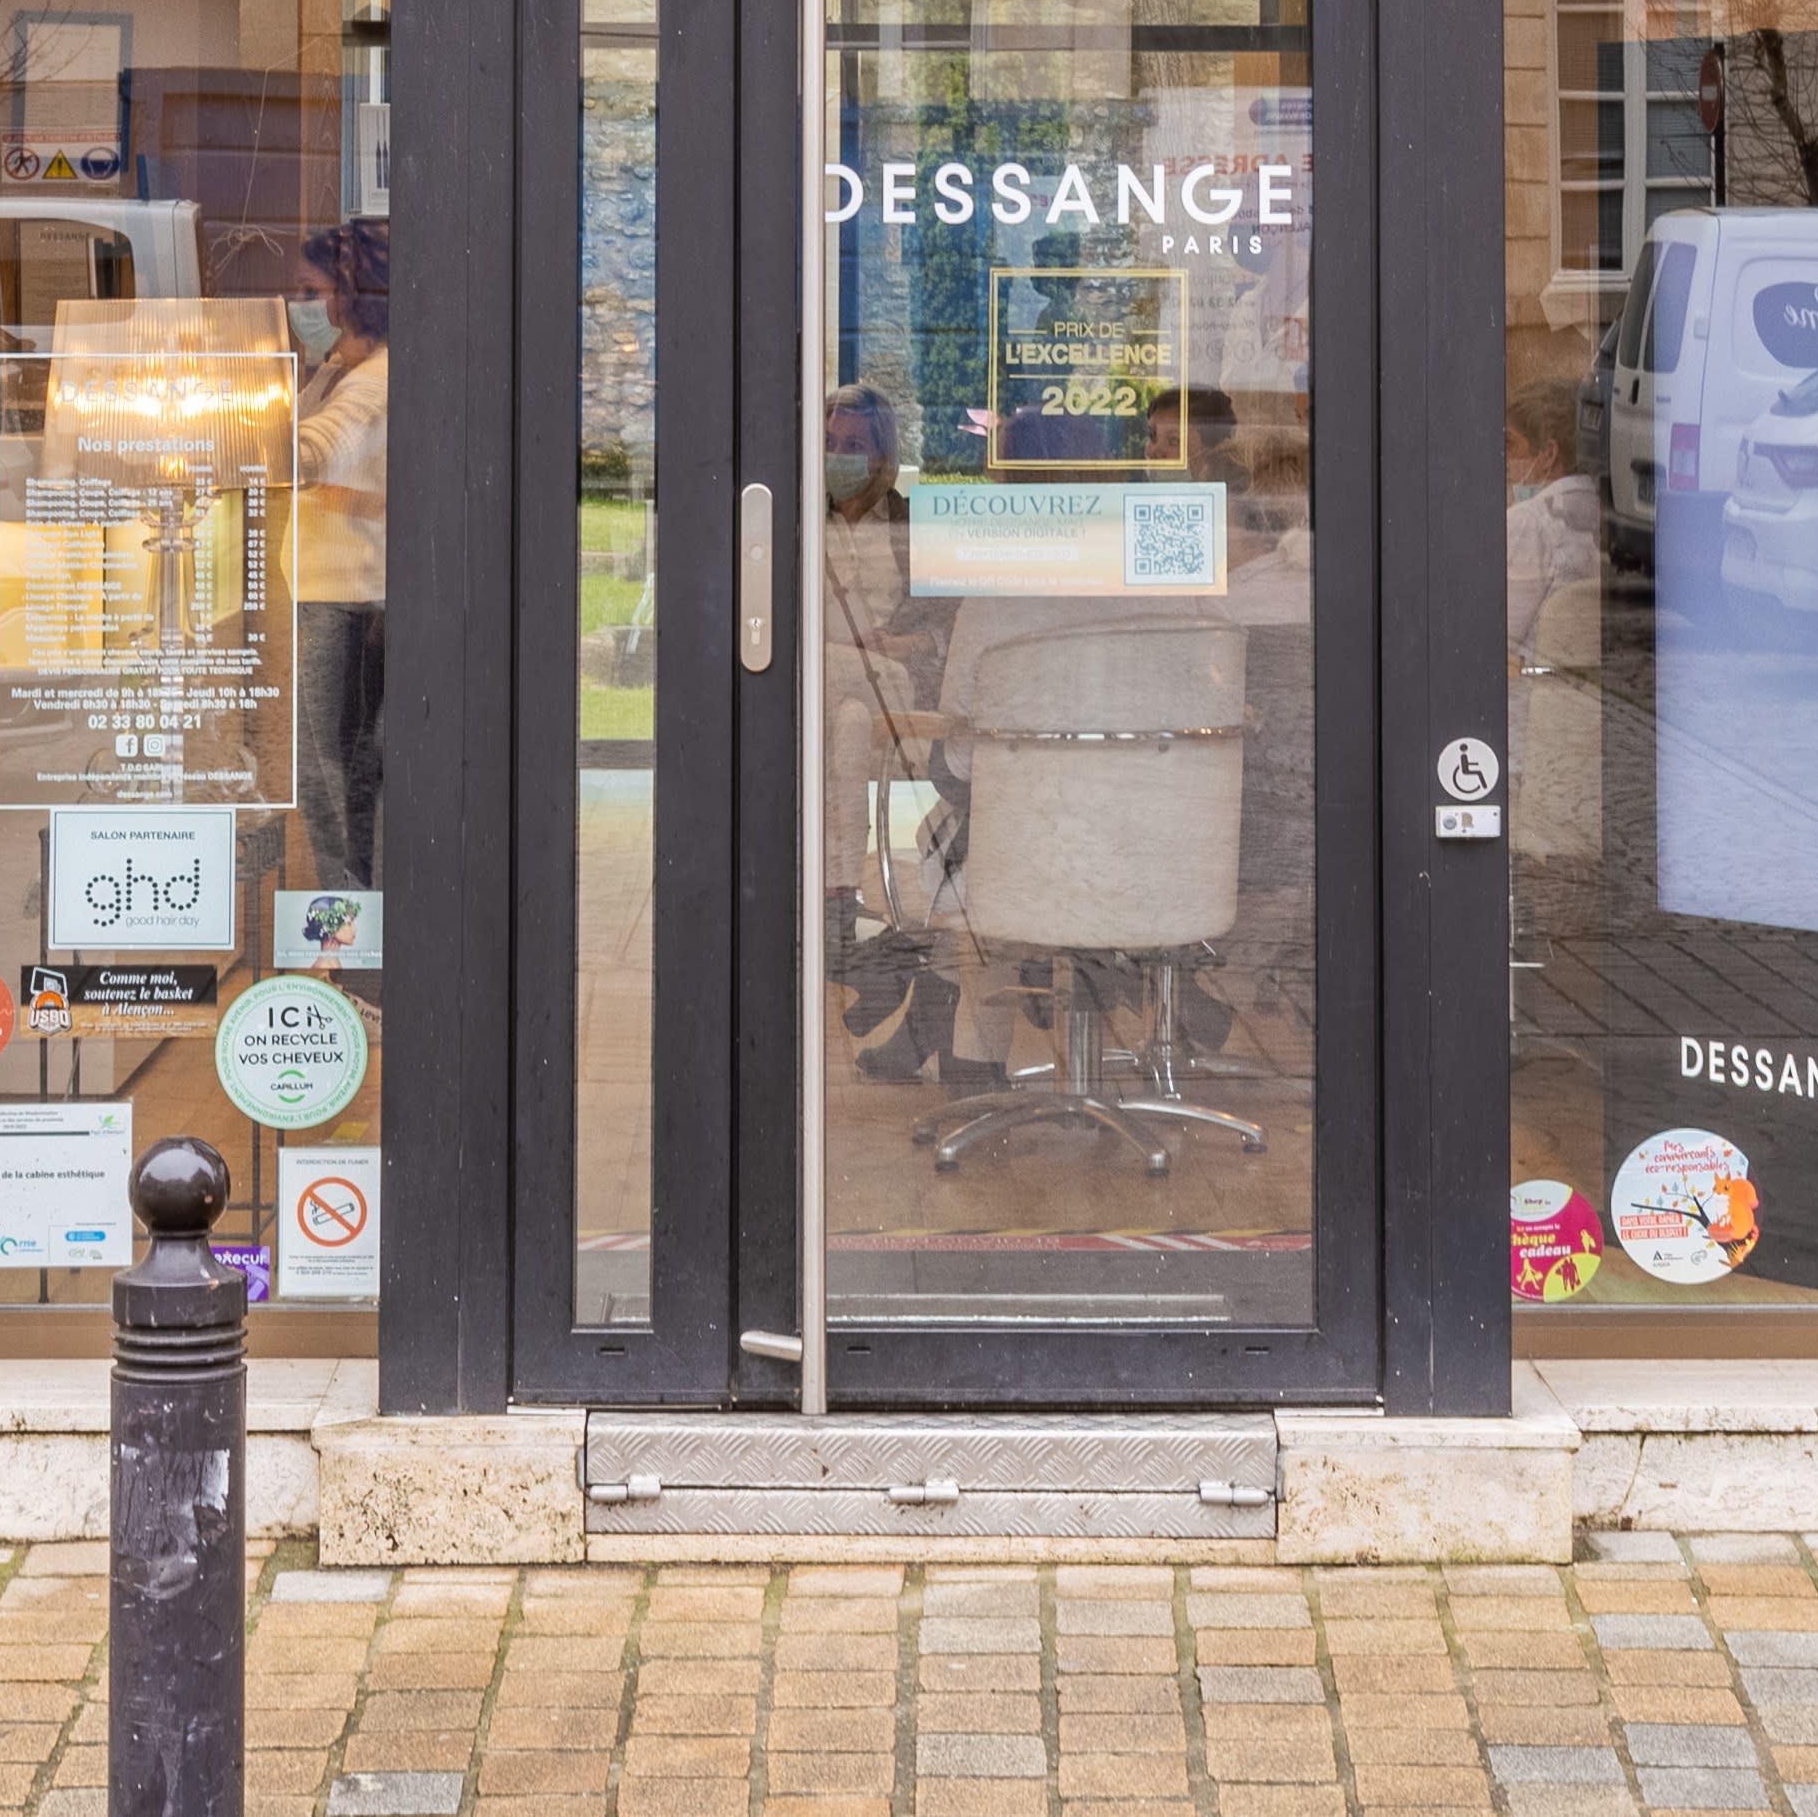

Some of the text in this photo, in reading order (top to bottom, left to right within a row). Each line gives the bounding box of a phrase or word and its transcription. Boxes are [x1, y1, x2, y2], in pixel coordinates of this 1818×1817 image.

[824, 162, 1293, 225] DESSANGE
[1162, 235, 1264, 256] PARIS
[1053, 320, 1125, 339] PRIX DE
[1005, 342, 1172, 367] L'EXCELLENCE
[1040, 385, 1139, 417] 2022
[78, 437, 215, 455] Nos prestations
[933, 489, 1103, 517] DÉCOUVREZ
[967, 527, 1078, 539] VERSION DIGITALE
[11, 686, 42, 699] Mardi
[45, 686, 56, 699] et
[57, 686, 104, 699] mercredi
[105, 686, 120, 699] de
[121, 686, 135, 699] 9h
[186, 686, 215, 699] Jeudi
[218, 686, 237, 699] 10h
[248, 686, 280, 699] 18h30
[33, 699, 81, 711] Vendredi
[83, 699, 109, 711] 8h30
[121, 699, 152, 711] 18h30
[201, 699, 227, 711] 8h30
[239, 699, 258, 711] 18h
[87, 714, 202, 730] 02 33 80 04 21
[90, 831, 196, 841] SALON PARTENAIRE
[85, 857, 201, 928] ghd
[125, 914, 200, 930] good hair day
[99, 970, 178, 986] Comme moi,
[84, 985, 194, 1002] soutenez le basket
[102, 1002, 175, 1019] à Alençon...
[244, 1032, 338, 1047] ON RECYCLE
[239, 1051, 344, 1065] VOS CHEVEUX
[270, 1082, 314, 1091] CAPILLUM
[2, 1170, 13, 1181] de
[14, 1170, 23, 1181] la
[25, 1170, 55, 1181] cabine
[57, 1170, 106, 1181] esthétique
[1645, 1160, 1730, 1176] éco-responsables
[1511, 1232, 1556, 1247] hèque
[1519, 1244, 1572, 1259] cadeau
